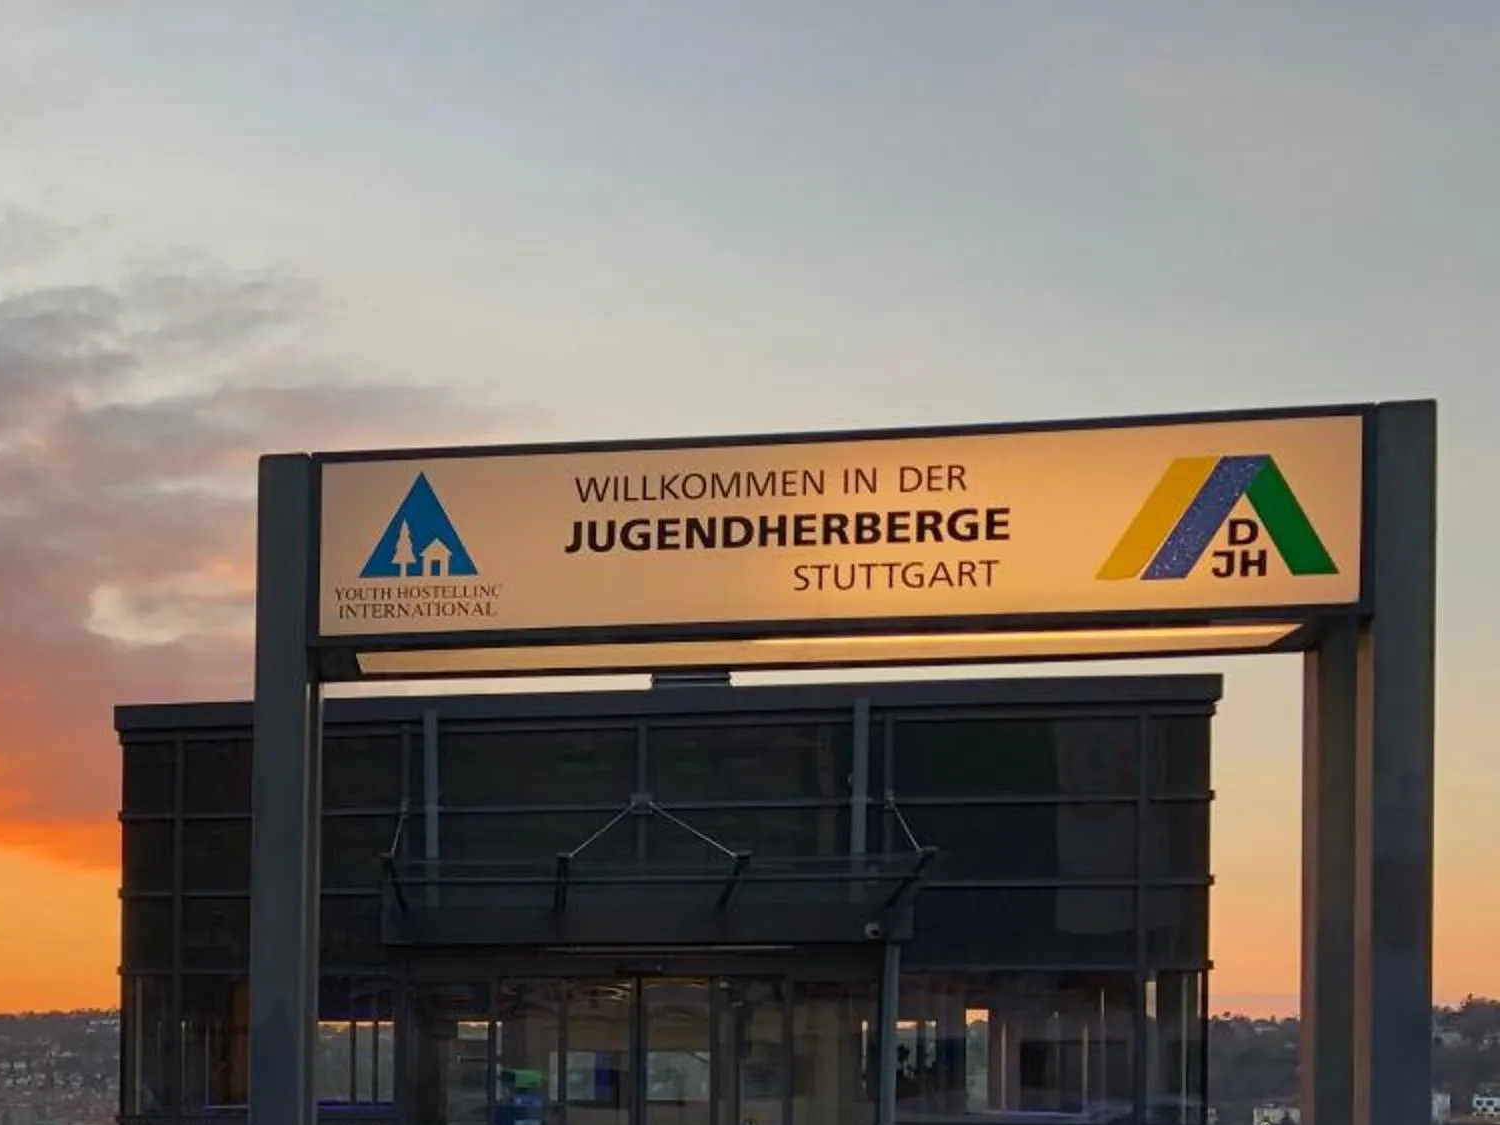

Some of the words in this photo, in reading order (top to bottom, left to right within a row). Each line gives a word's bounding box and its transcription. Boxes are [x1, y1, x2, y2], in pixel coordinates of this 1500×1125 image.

[574, 469, 825, 503] WILLKOMMEN
[842, 467, 878, 495] IN
[899, 464, 968, 493] DER
[564, 507, 1011, 553] JUGENDHERBERGE
[1227, 518, 1260, 546] D
[793, 560, 1000, 592] STUTTGART
[1211, 549, 1267, 578] JH
[334, 586, 392, 601] YOUTH
[338, 602, 498, 619] INTERNATIONAL
